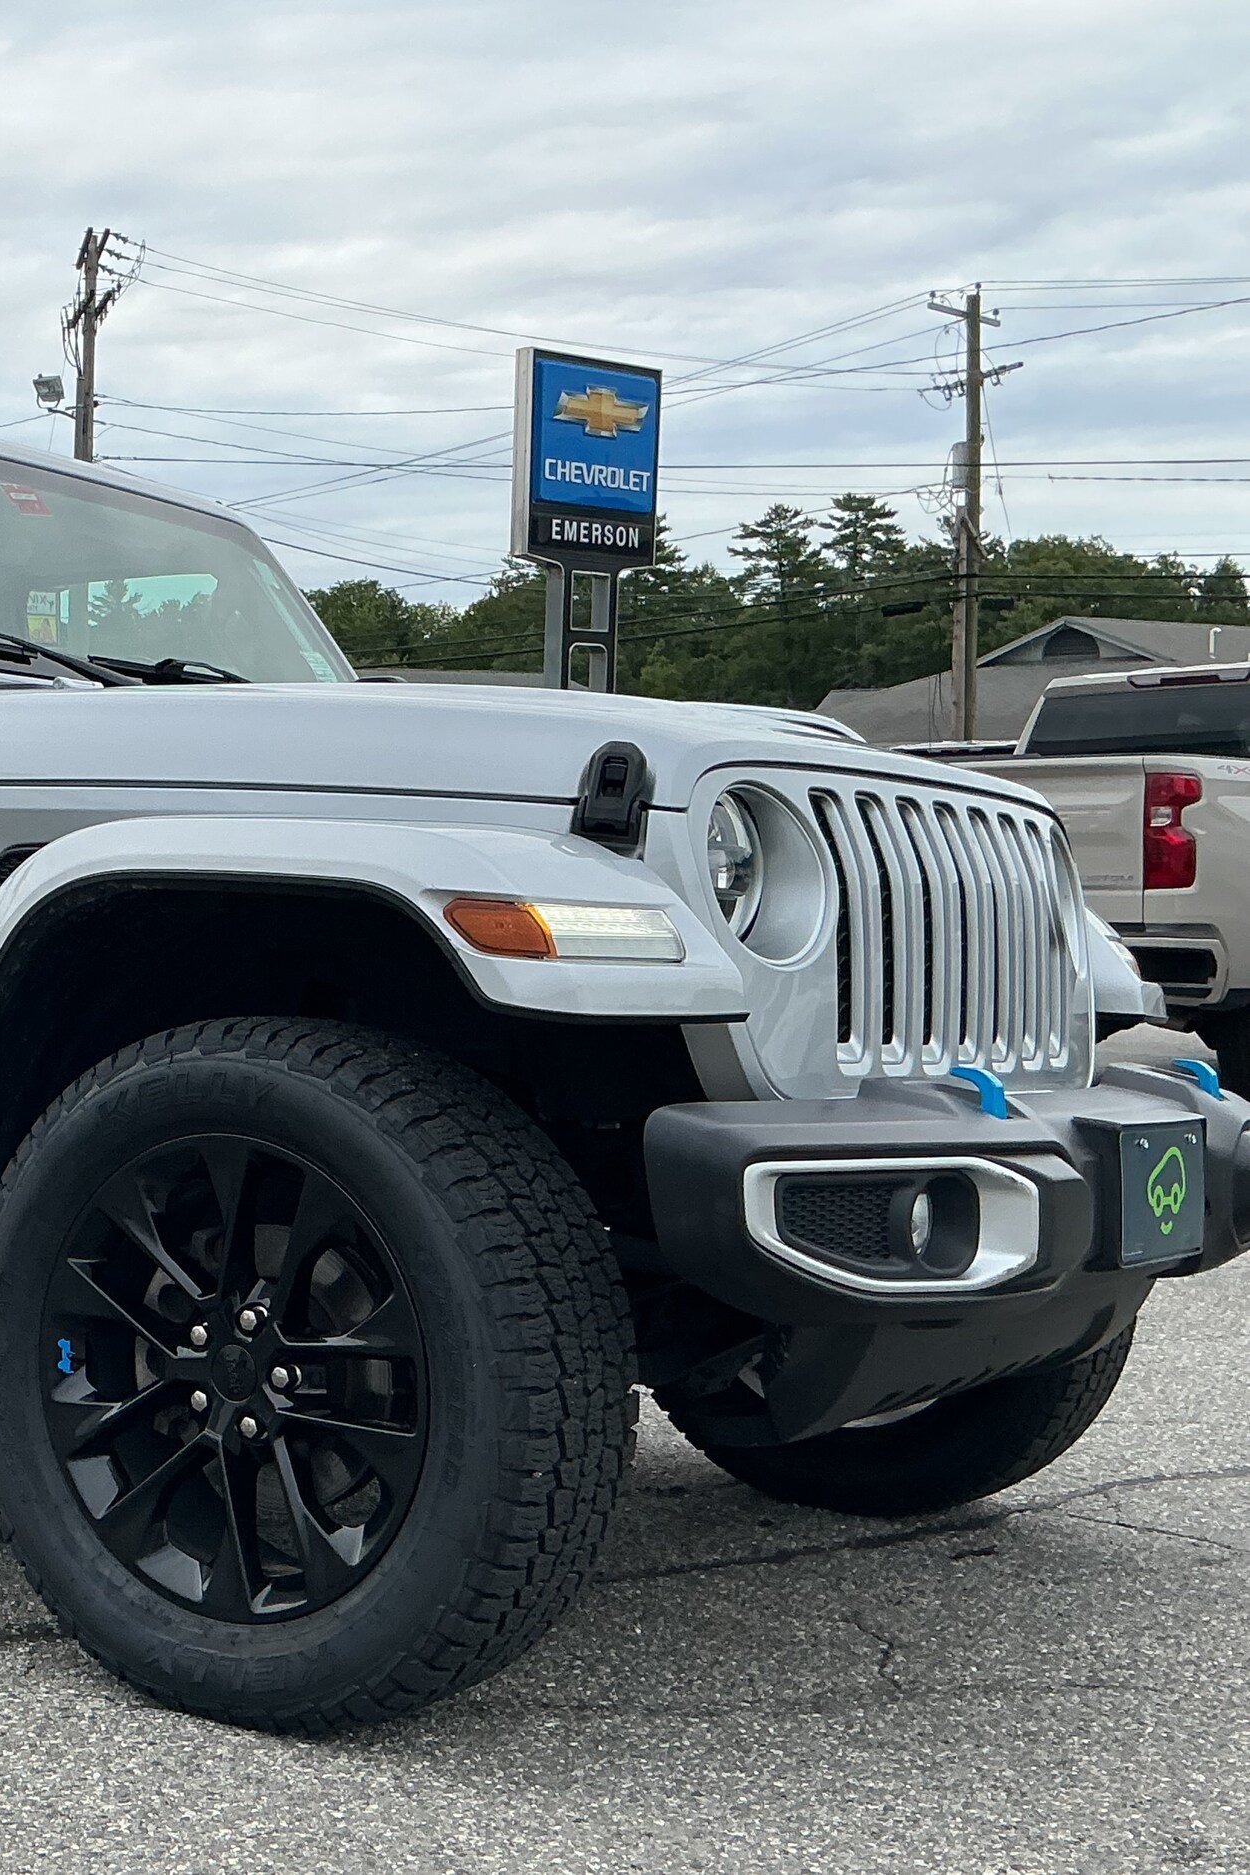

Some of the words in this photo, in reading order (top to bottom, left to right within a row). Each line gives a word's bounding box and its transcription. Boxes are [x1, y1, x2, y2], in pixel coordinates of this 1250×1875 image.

[544, 459, 651, 492] CHEVROLET
[551, 519, 639, 549] EMERSON
[98, 1071, 278, 1122] KELLY
